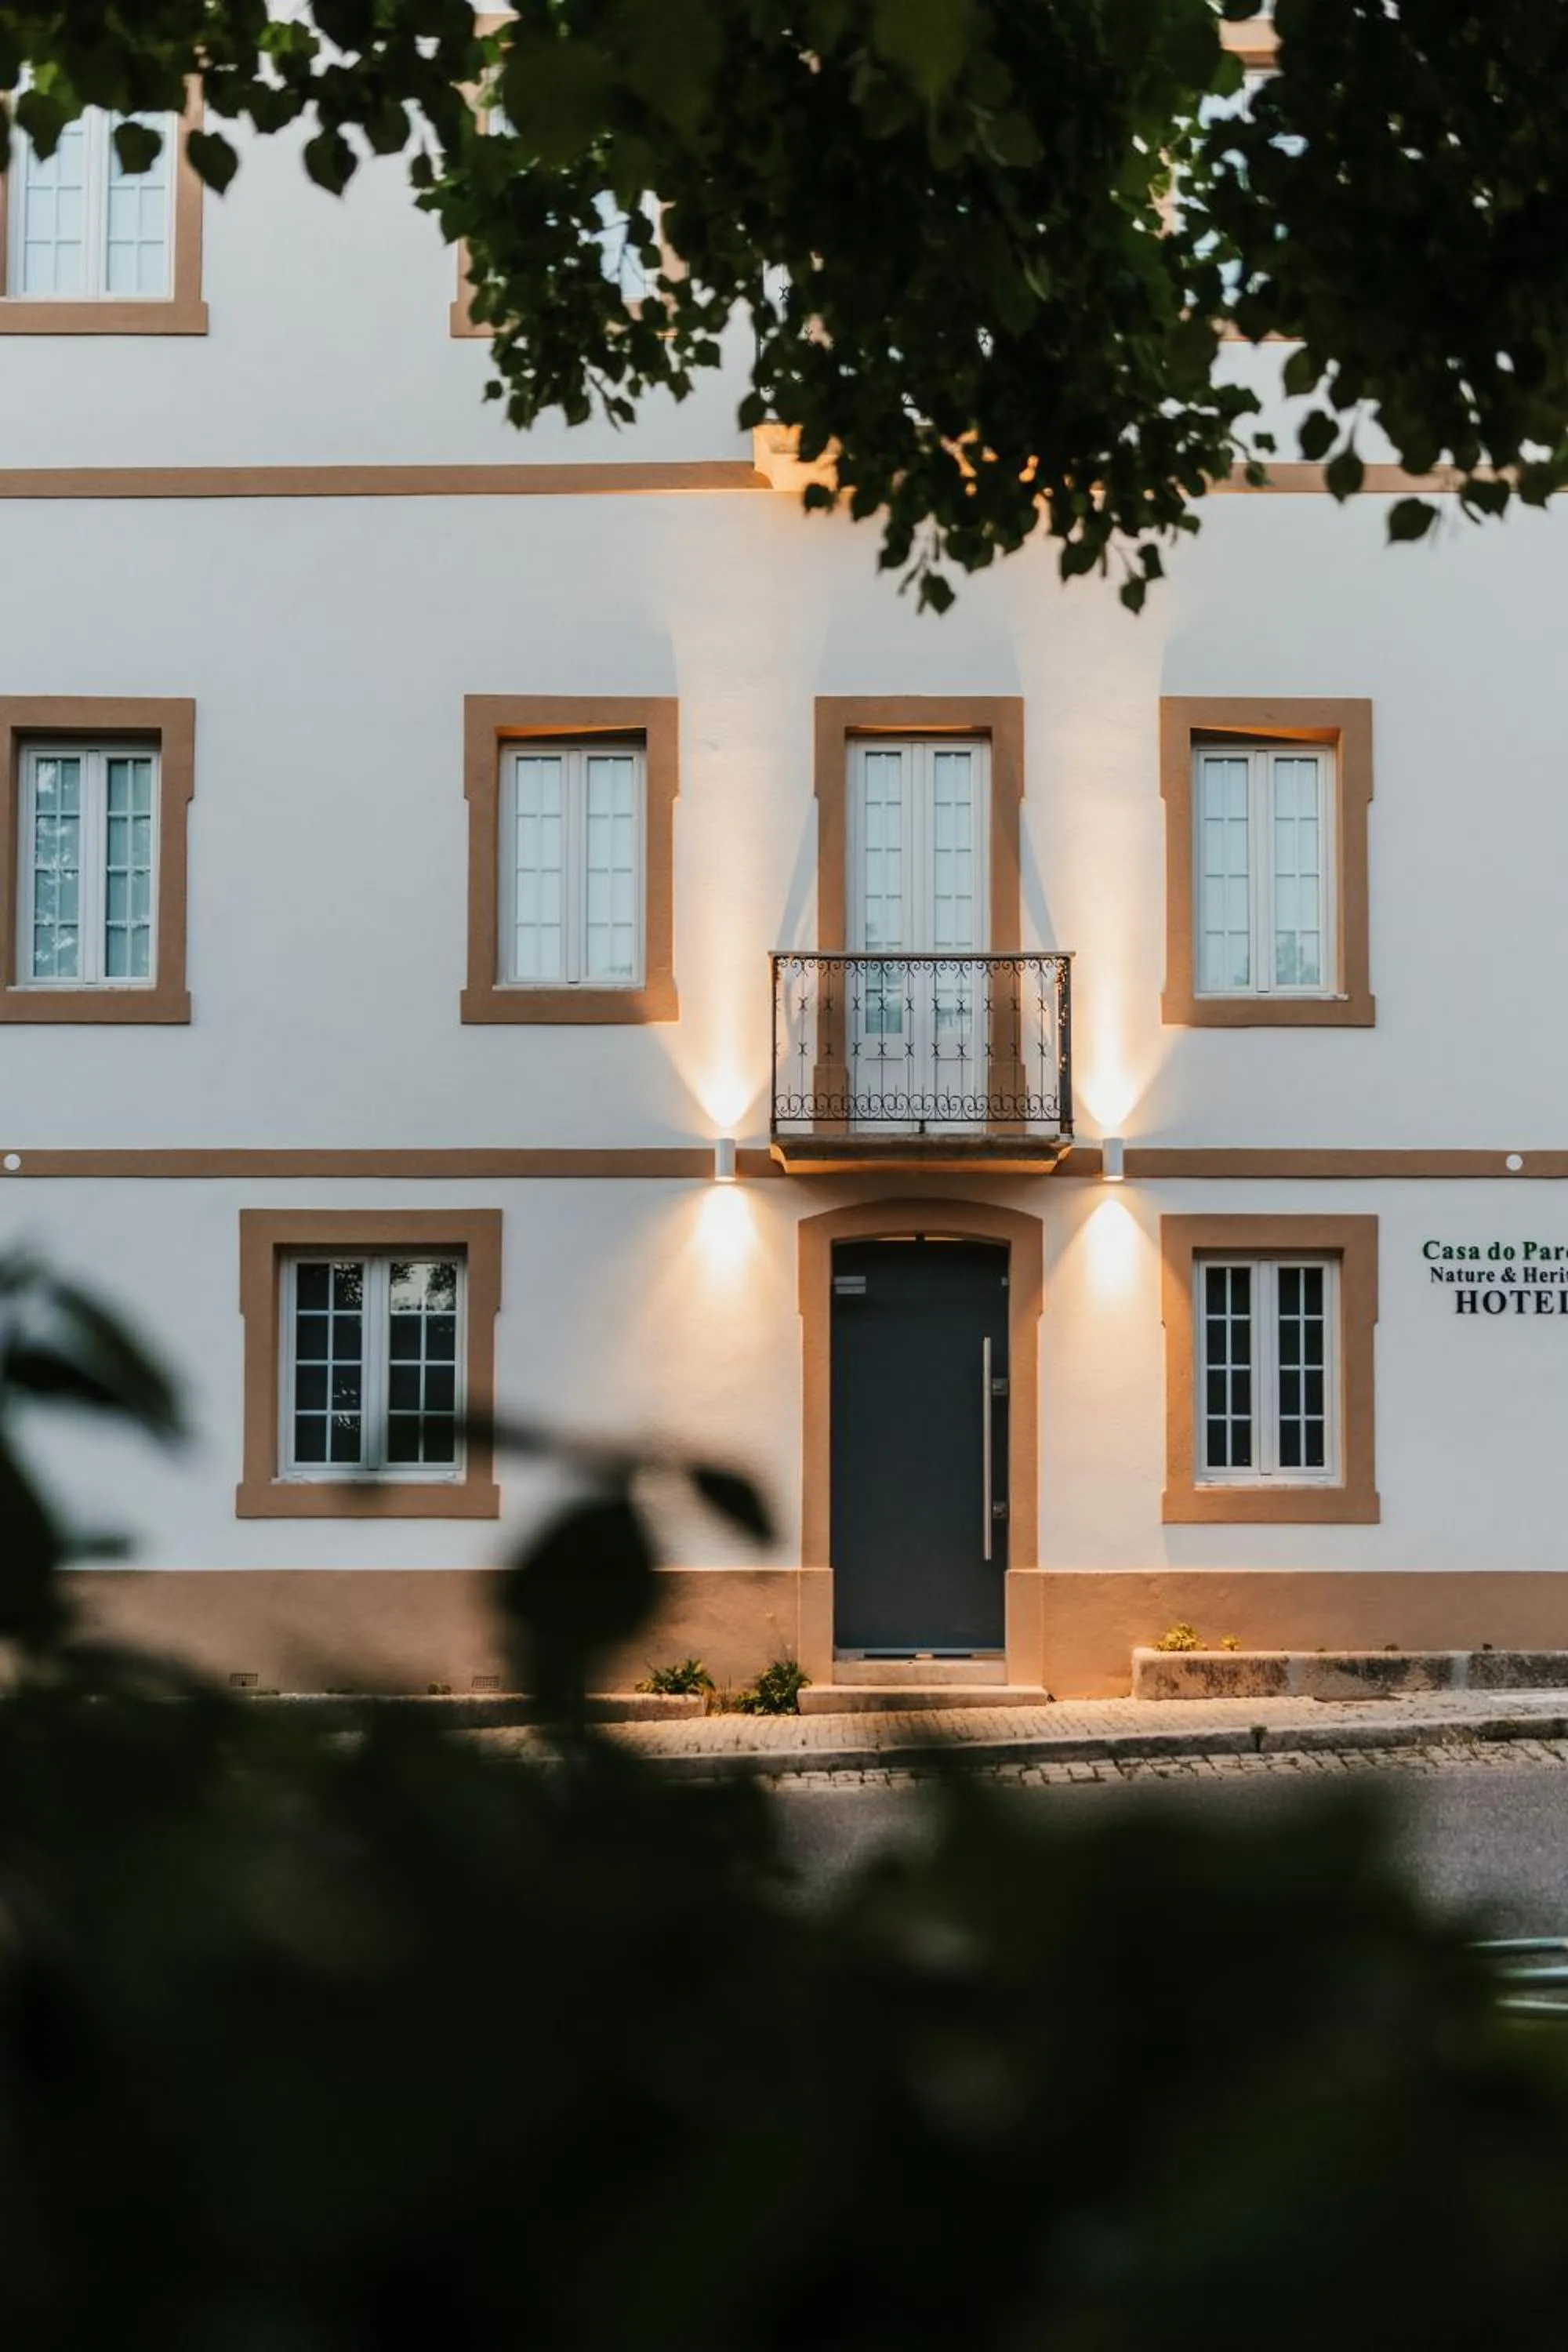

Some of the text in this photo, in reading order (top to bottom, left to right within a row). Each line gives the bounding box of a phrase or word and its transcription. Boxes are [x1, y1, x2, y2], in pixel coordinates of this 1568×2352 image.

[1422, 1240, 1568, 1261] Casa do Par
[1430, 1266, 1496, 1283] Nature
[1501, 1266, 1516, 1283] &
